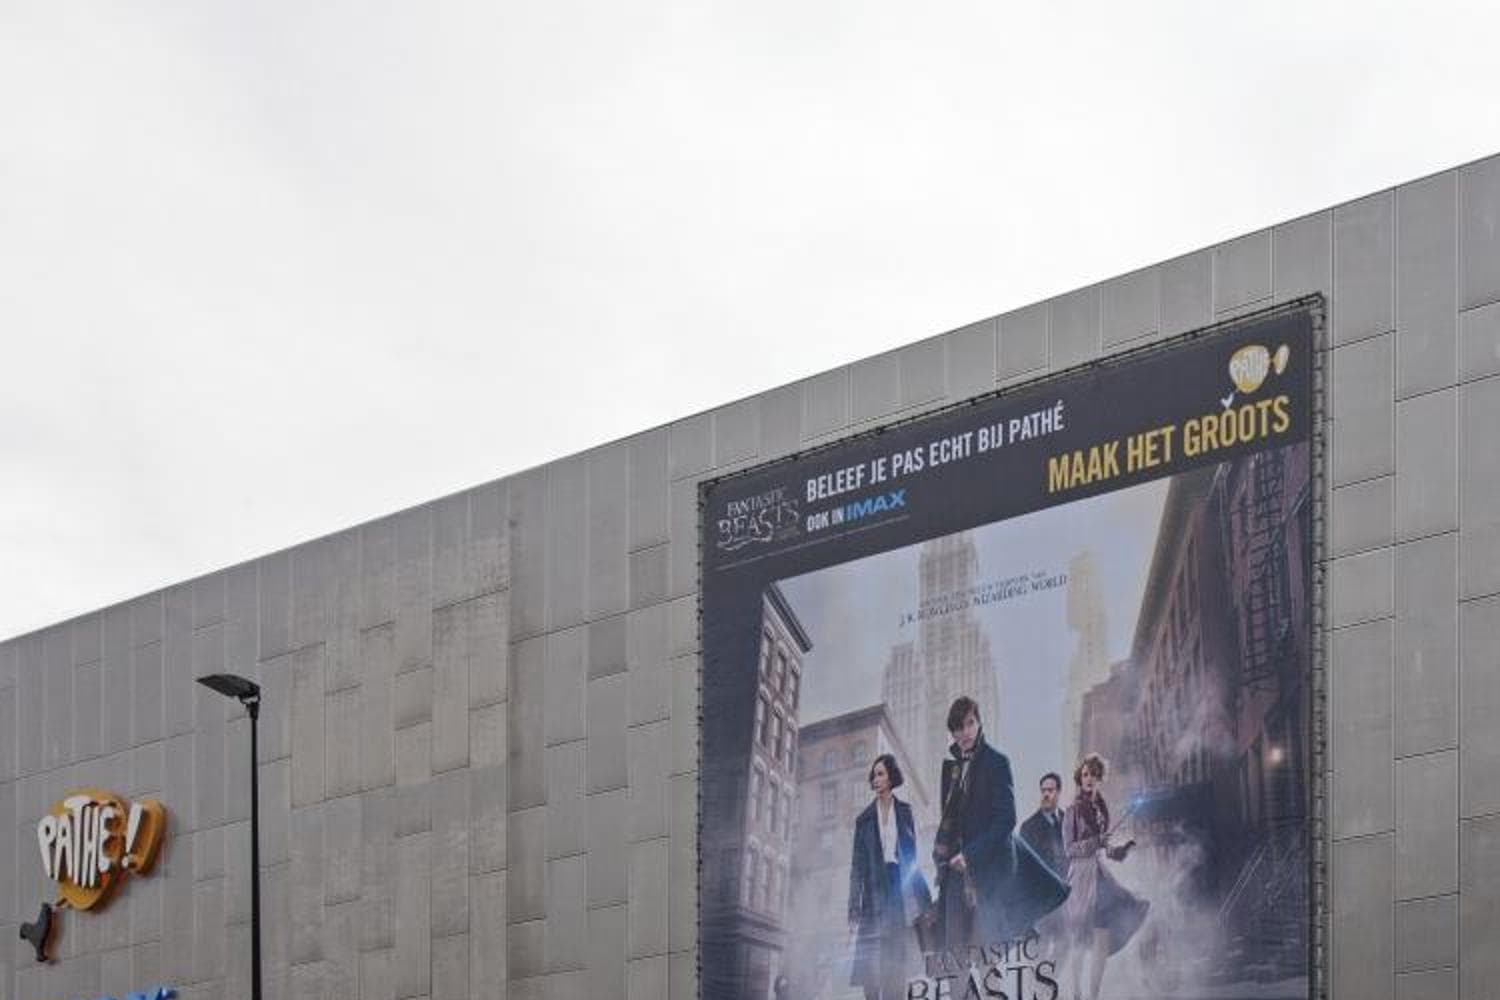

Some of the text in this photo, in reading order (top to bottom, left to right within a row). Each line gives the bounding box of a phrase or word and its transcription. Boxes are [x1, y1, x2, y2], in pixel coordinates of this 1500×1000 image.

[807, 399, 1066, 503] BELEEF JE PAS ECHT BIJ PATHÉ
[1048, 395, 1290, 493] MAAK HET GROOTS
[807, 489, 907, 532] OOK IN IMAX
